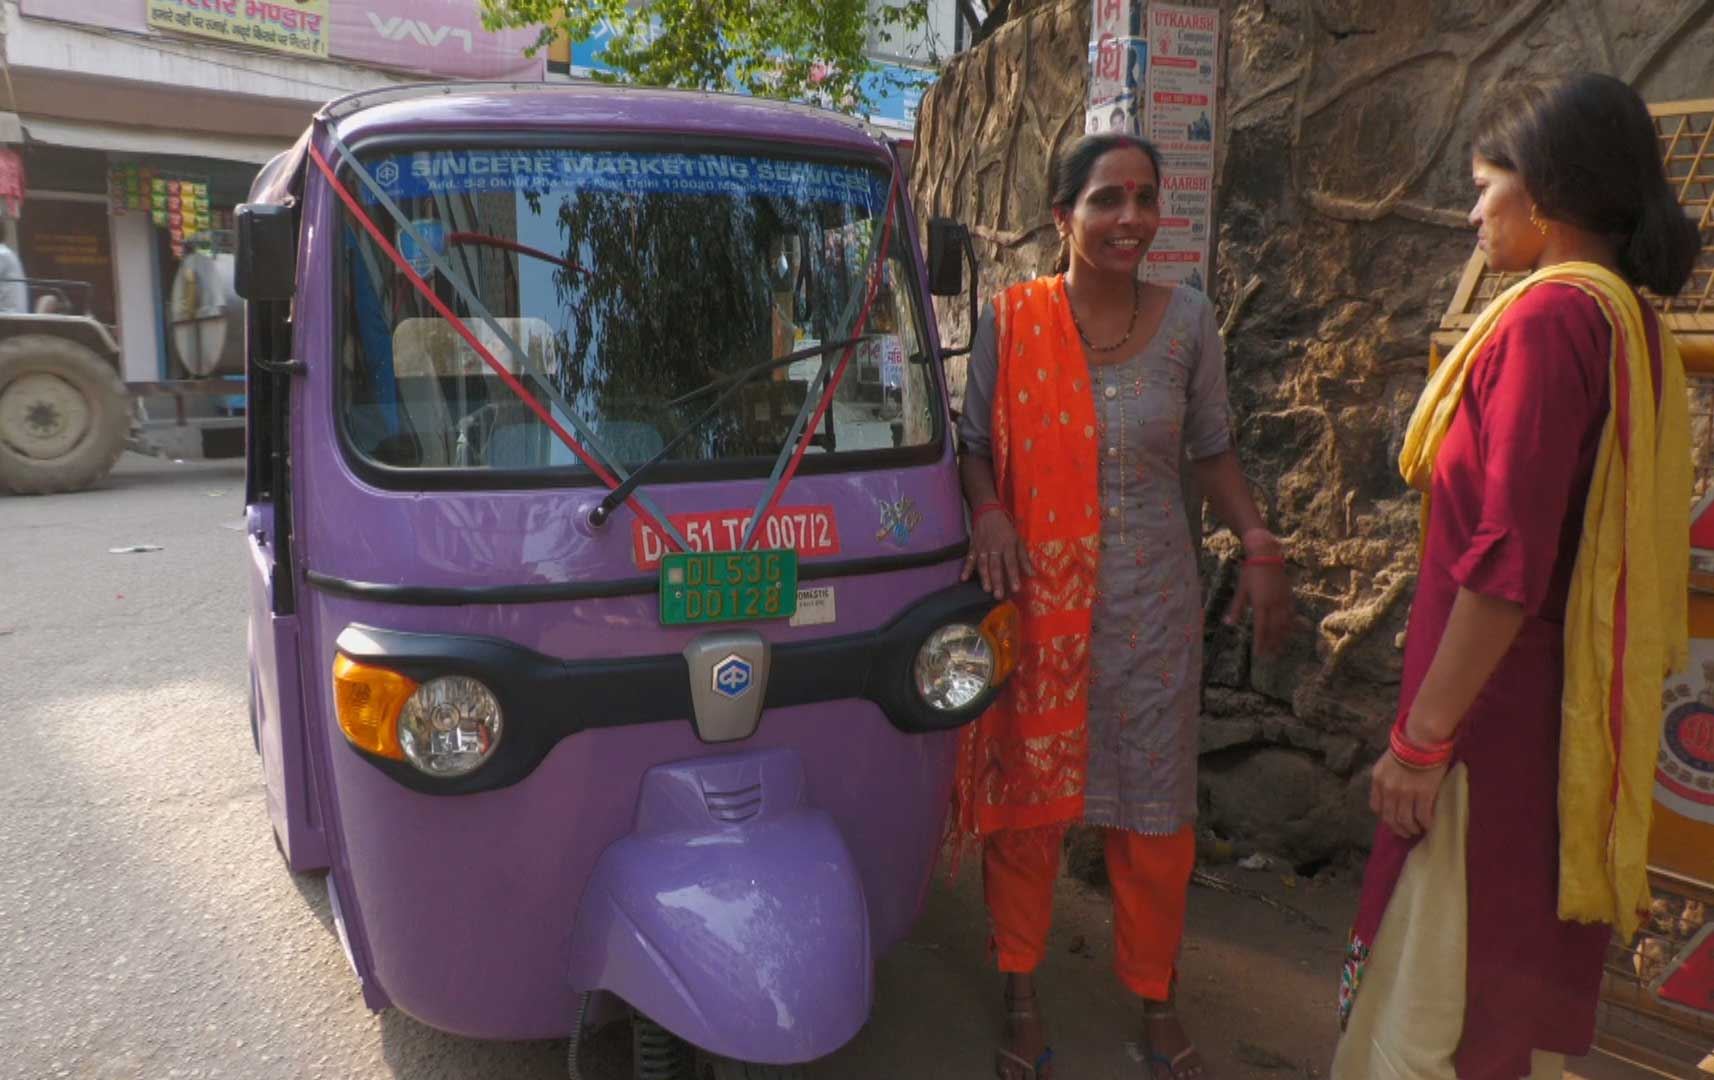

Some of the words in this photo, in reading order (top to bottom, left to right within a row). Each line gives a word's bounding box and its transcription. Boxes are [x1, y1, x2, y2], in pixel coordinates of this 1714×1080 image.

[245, 1, 323, 33] भण्डार
[1154, 11, 1214, 31] UTKAARSH
[411, 156, 553, 177] SINCERE
[562, 156, 748, 179] MARKETING
[1161, 175, 1207, 191] KAARSH
[641, 525, 672, 561] D
[686, 520, 713, 551] 51
[796, 589, 829, 602] OMESTIC
